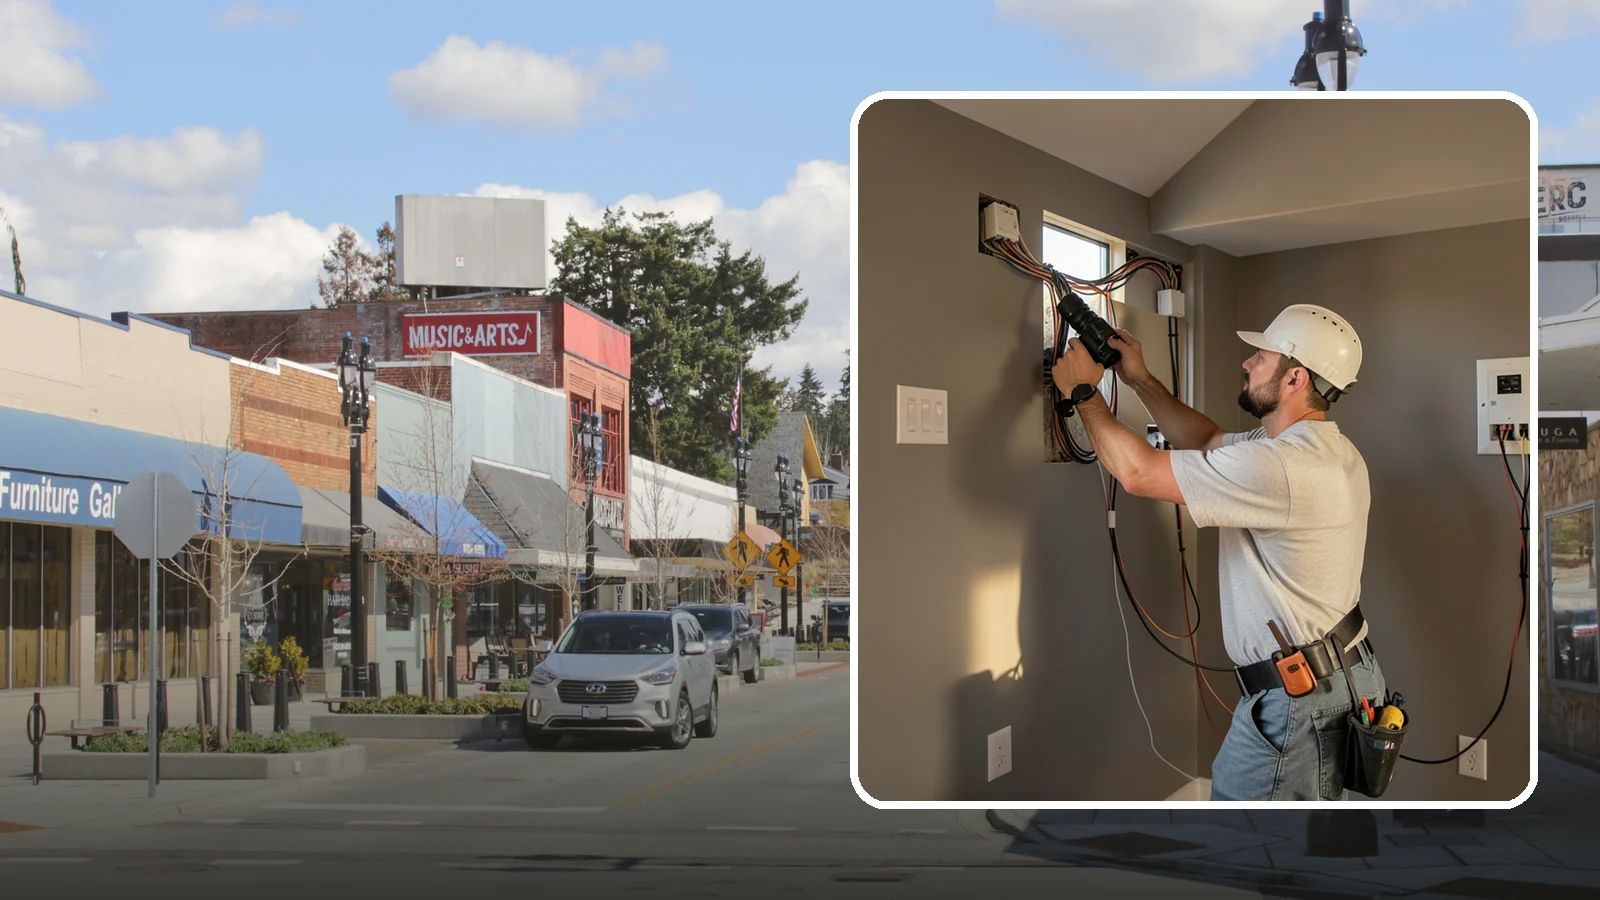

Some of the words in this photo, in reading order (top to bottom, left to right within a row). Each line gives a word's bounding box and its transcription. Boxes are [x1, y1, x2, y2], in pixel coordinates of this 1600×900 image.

[409, 322, 519, 349] MUSIC&ARTS
[0, 471, 79, 516] Furniture
[89, 482, 122, 520] Gal
